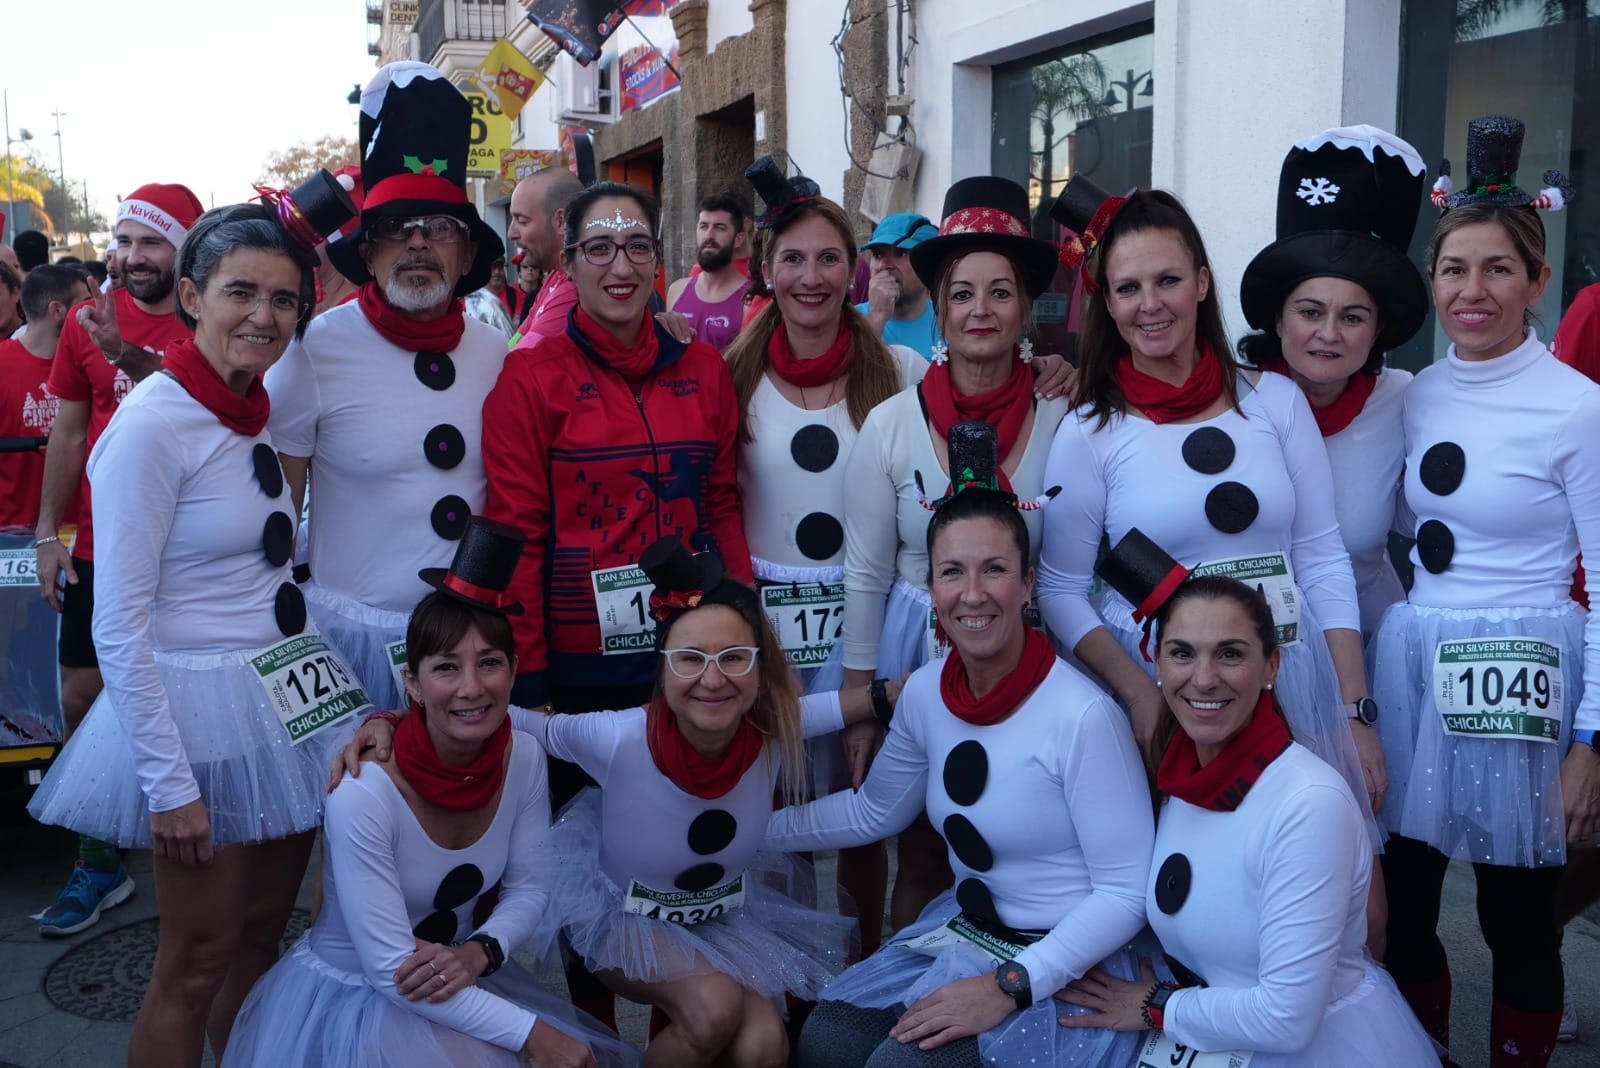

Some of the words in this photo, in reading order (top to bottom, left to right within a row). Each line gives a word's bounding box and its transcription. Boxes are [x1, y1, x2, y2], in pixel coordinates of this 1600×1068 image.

[468, 148, 495, 157] AGA
[128, 204, 173, 232] Navidad
[1194, 562, 1237, 577] SILVESTRE
[1238, 557, 1283, 570] CHICLANERA
[599, 573, 617, 583] SAN
[767, 590, 784, 599] SAN
[630, 591, 646, 626] 1
[1443, 644, 1464, 655] SAN
[1466, 642, 1511, 653] SILVESTRE
[1513, 642, 1558, 658] CHICLANERA
[256, 654, 275, 668] SAN
[286, 655, 350, 705] 1279
[1459, 666, 1550, 709] 1049
[289, 701, 348, 735] CHICLANA
[1446, 717, 1513, 731] CHICLANA
